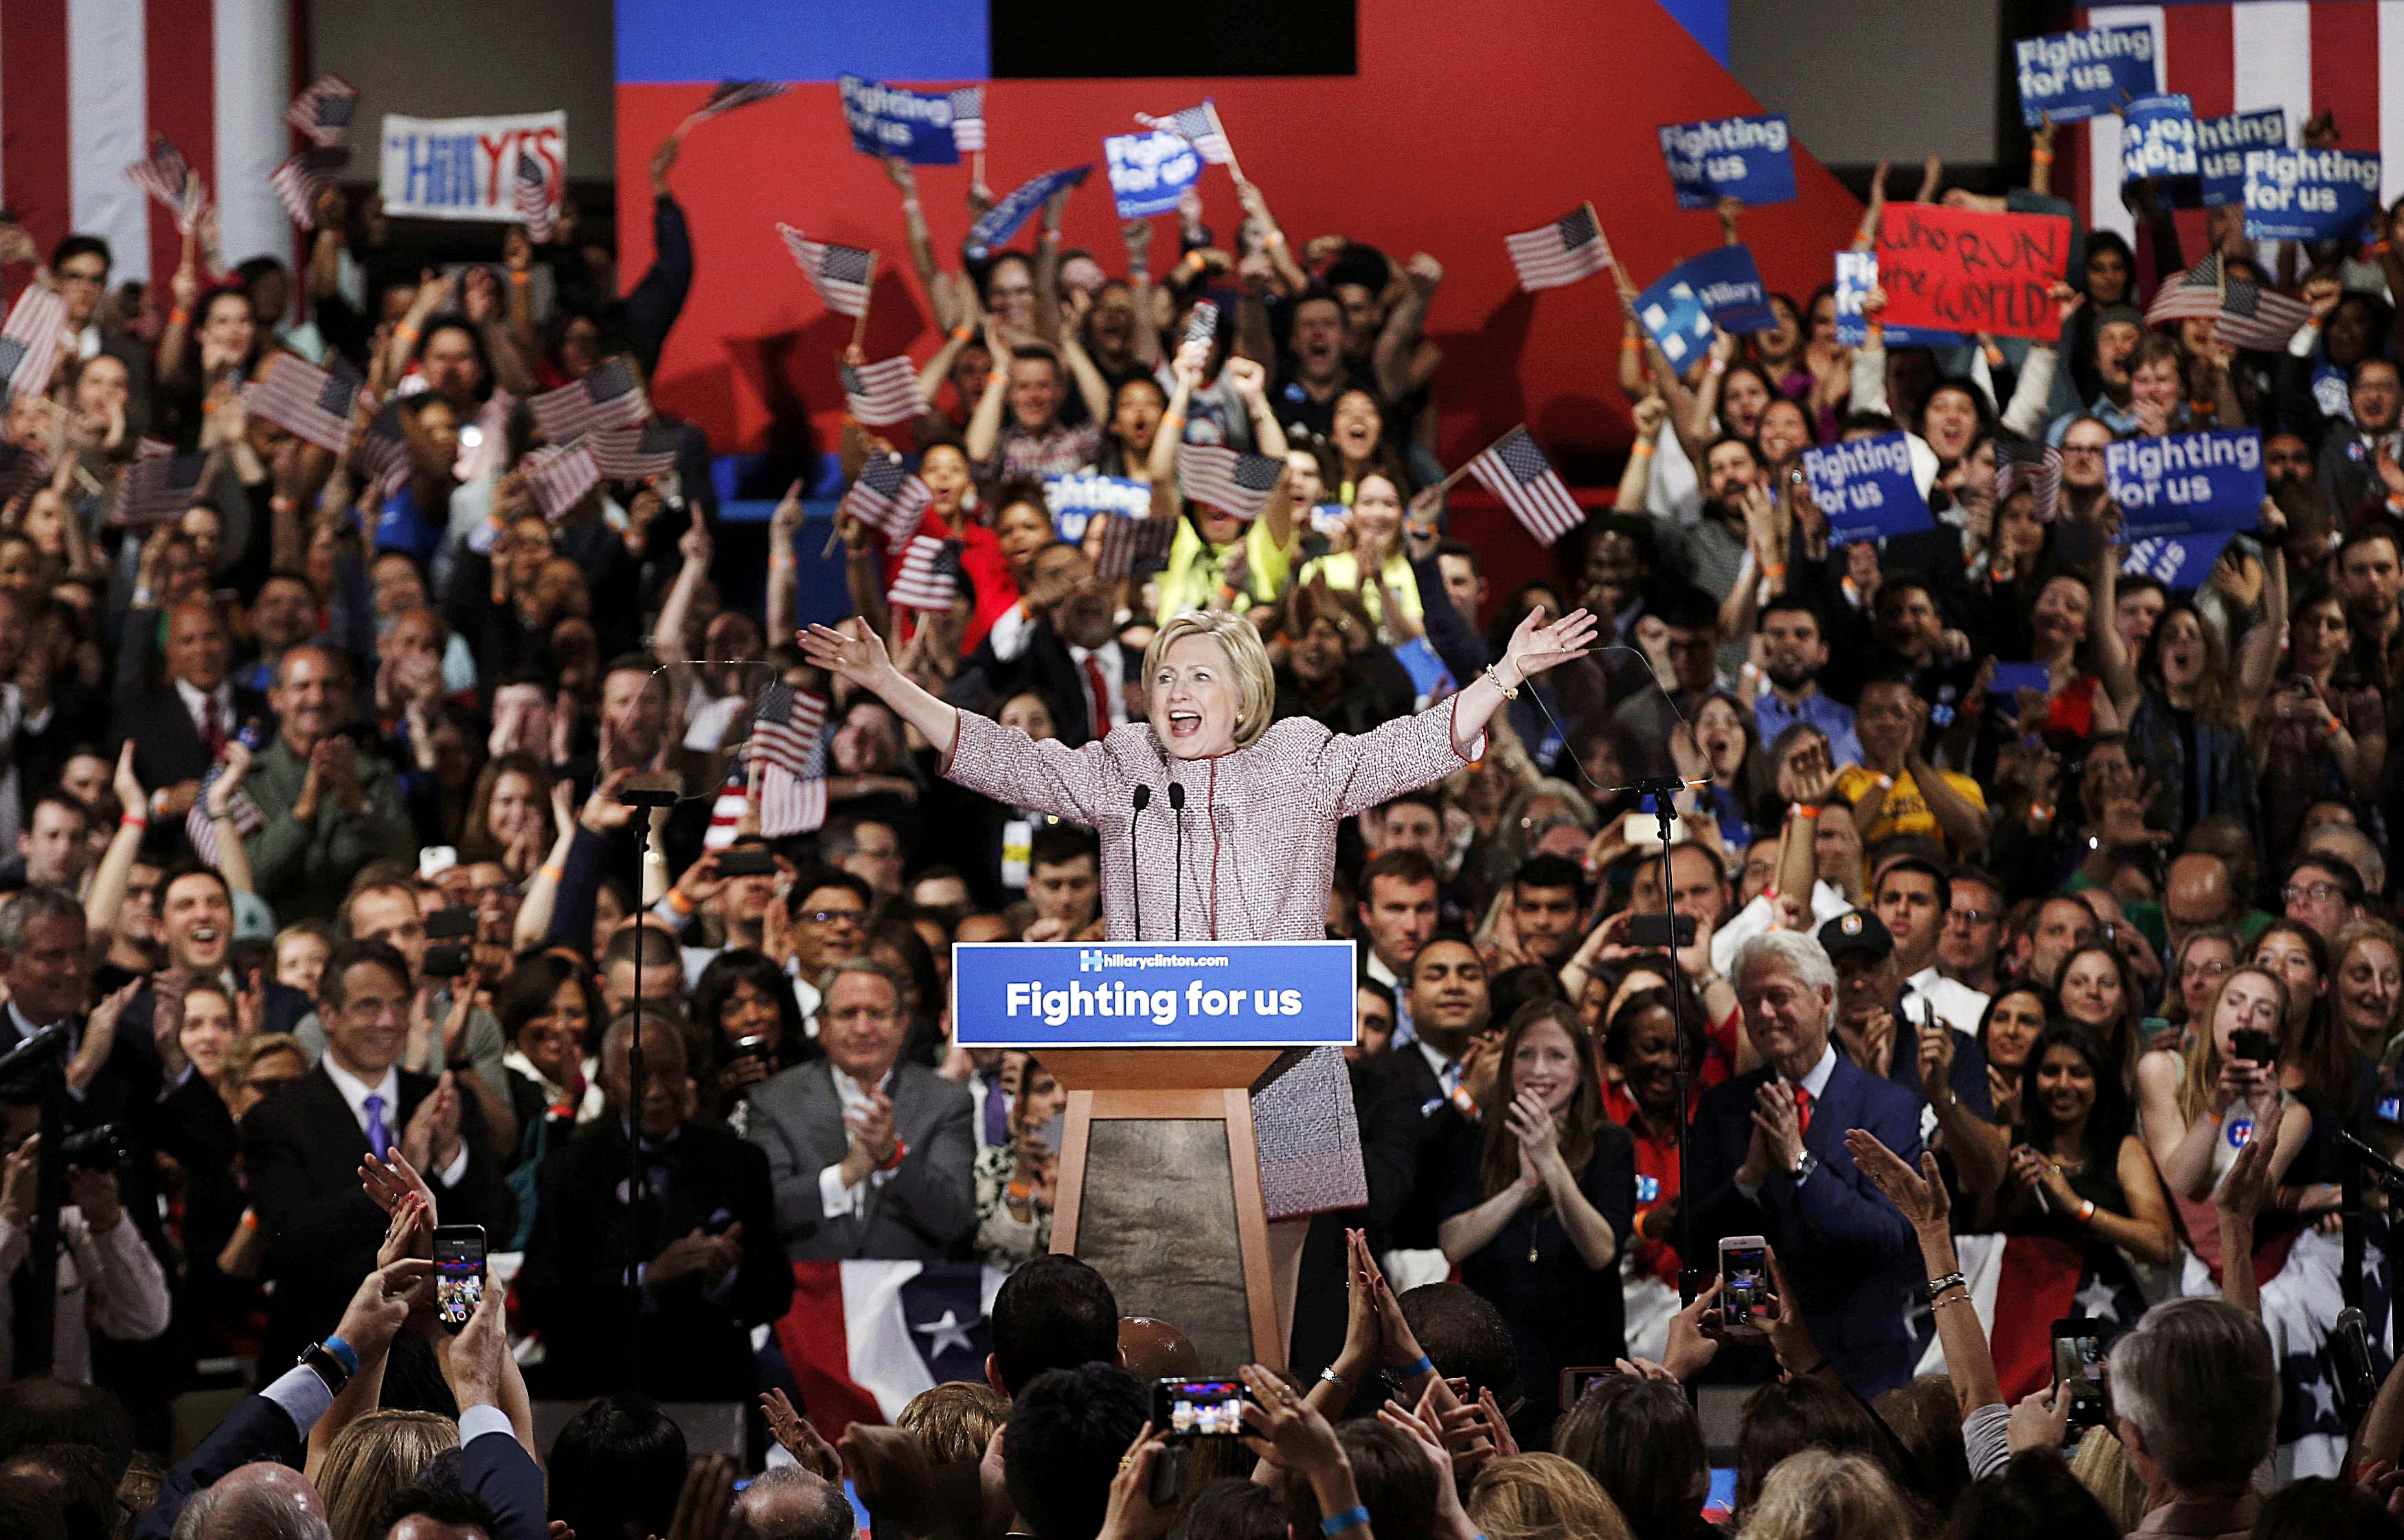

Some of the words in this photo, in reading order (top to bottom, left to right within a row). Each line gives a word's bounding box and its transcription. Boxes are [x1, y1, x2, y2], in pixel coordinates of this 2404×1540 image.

[2017, 27, 2152, 67] Fighting
[2019, 65, 2069, 98] for
[2072, 64, 2113, 91] us
[1659, 117, 1788, 156] Fighting
[1707, 155, 1748, 181] us
[2245, 148, 2380, 192] Fighting
[2243, 176, 2294, 211] for
[2298, 185, 2338, 213] us
[1803, 437, 1911, 489] Fighting
[2107, 431, 2261, 481] Fighting
[1848, 480, 1885, 510] us
[2166, 474, 2213, 506] us
[1104, 953, 1229, 970] hillaryclinton.com
[1006, 980, 1177, 1026] Fighting
[1185, 980, 1247, 1016] for
[1254, 988, 1303, 1016] us
